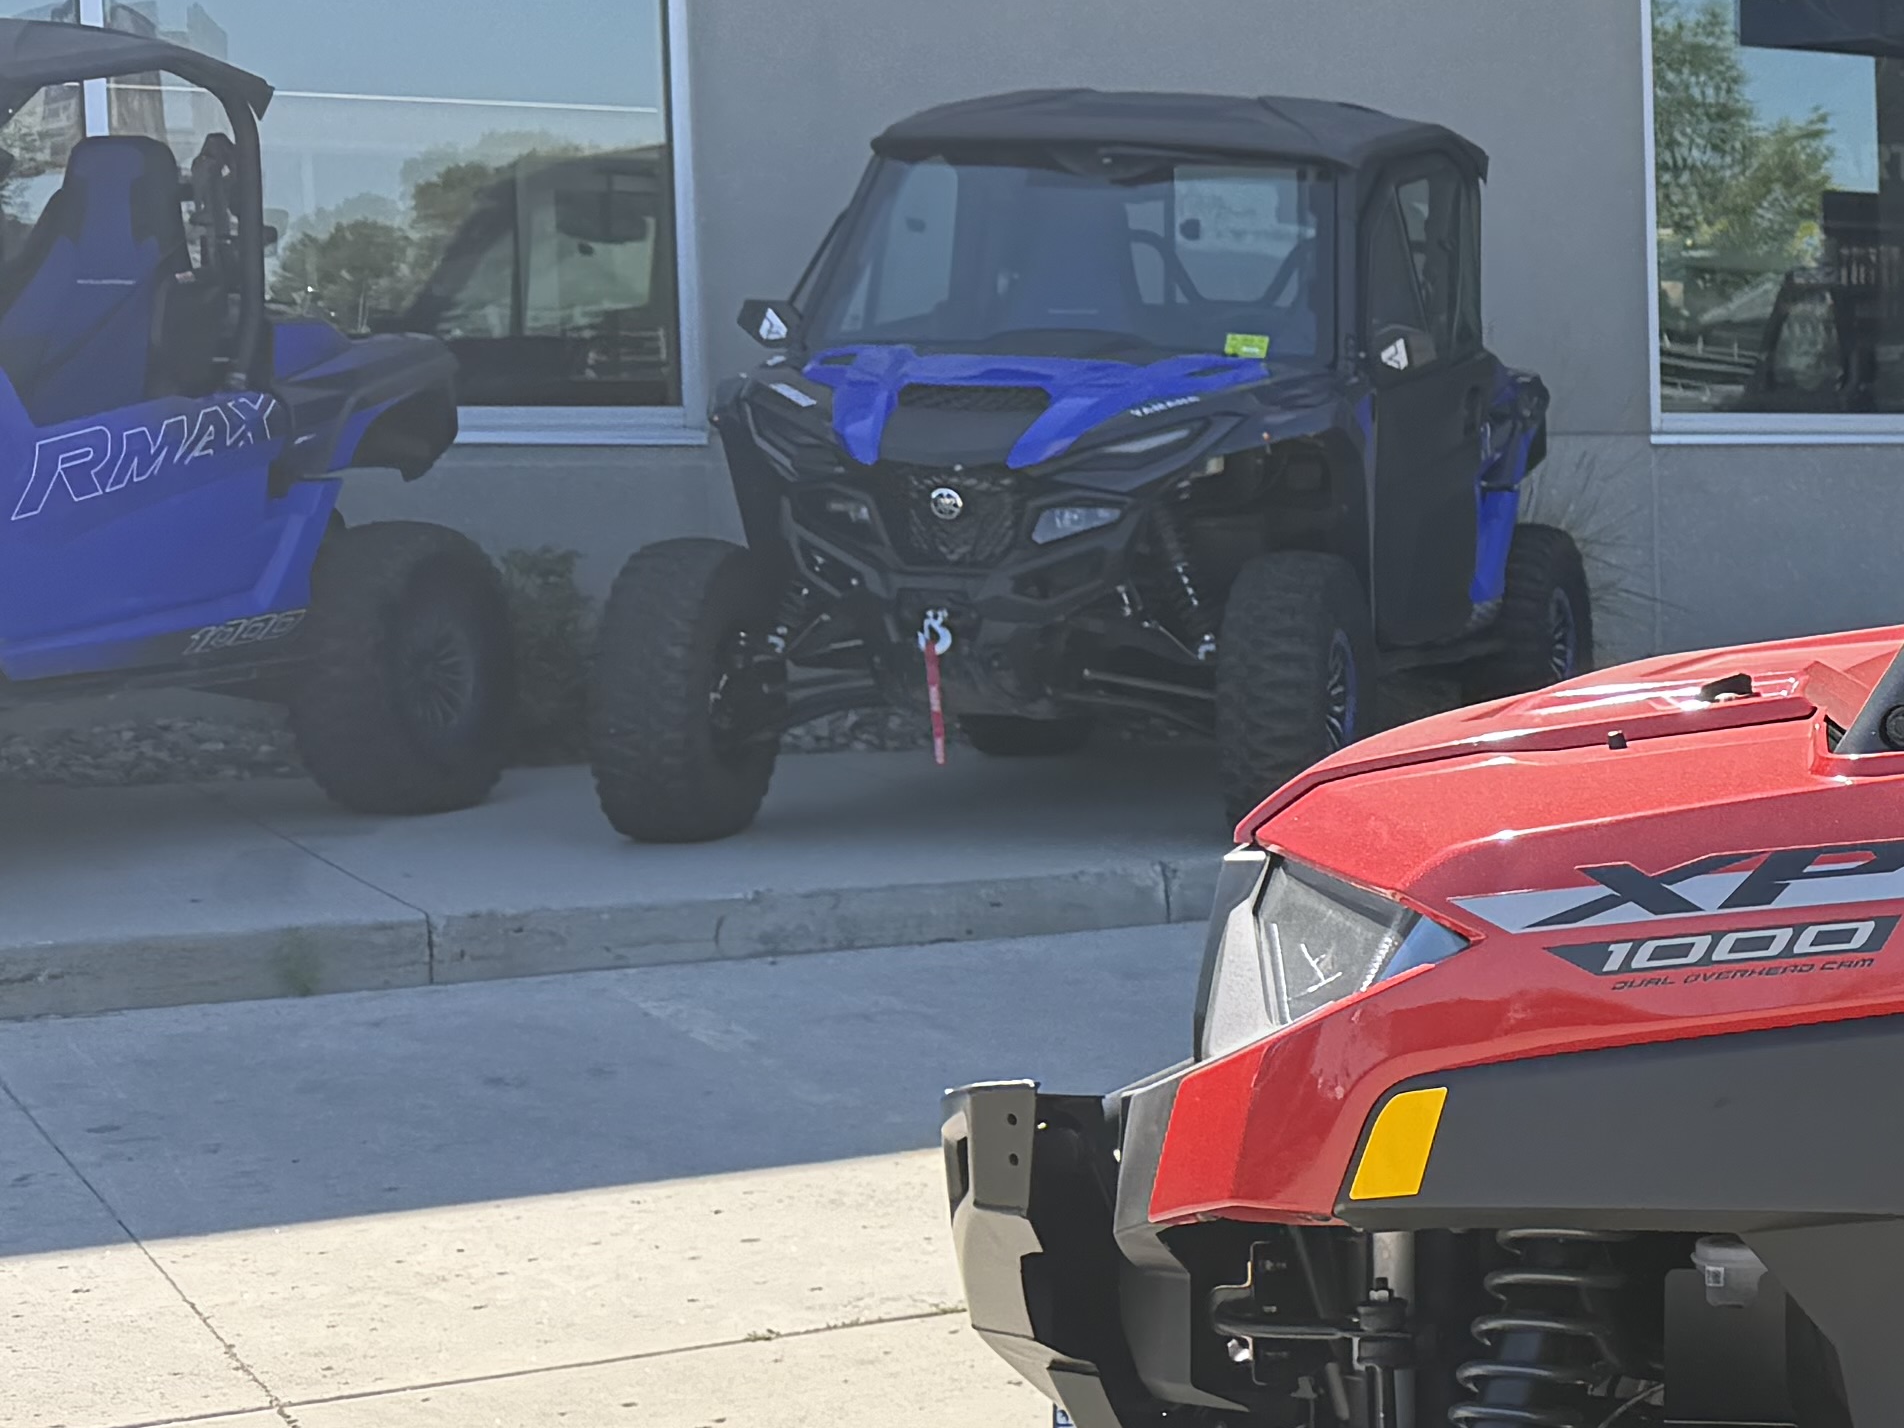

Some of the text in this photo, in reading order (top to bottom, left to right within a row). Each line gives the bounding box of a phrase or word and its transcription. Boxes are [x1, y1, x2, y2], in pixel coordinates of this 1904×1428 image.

[11, 393, 276, 521] RMAX
[1602, 920, 1876, 973] 1000
[1611, 957, 1875, 991] DUAL OVERHEAD CAM
